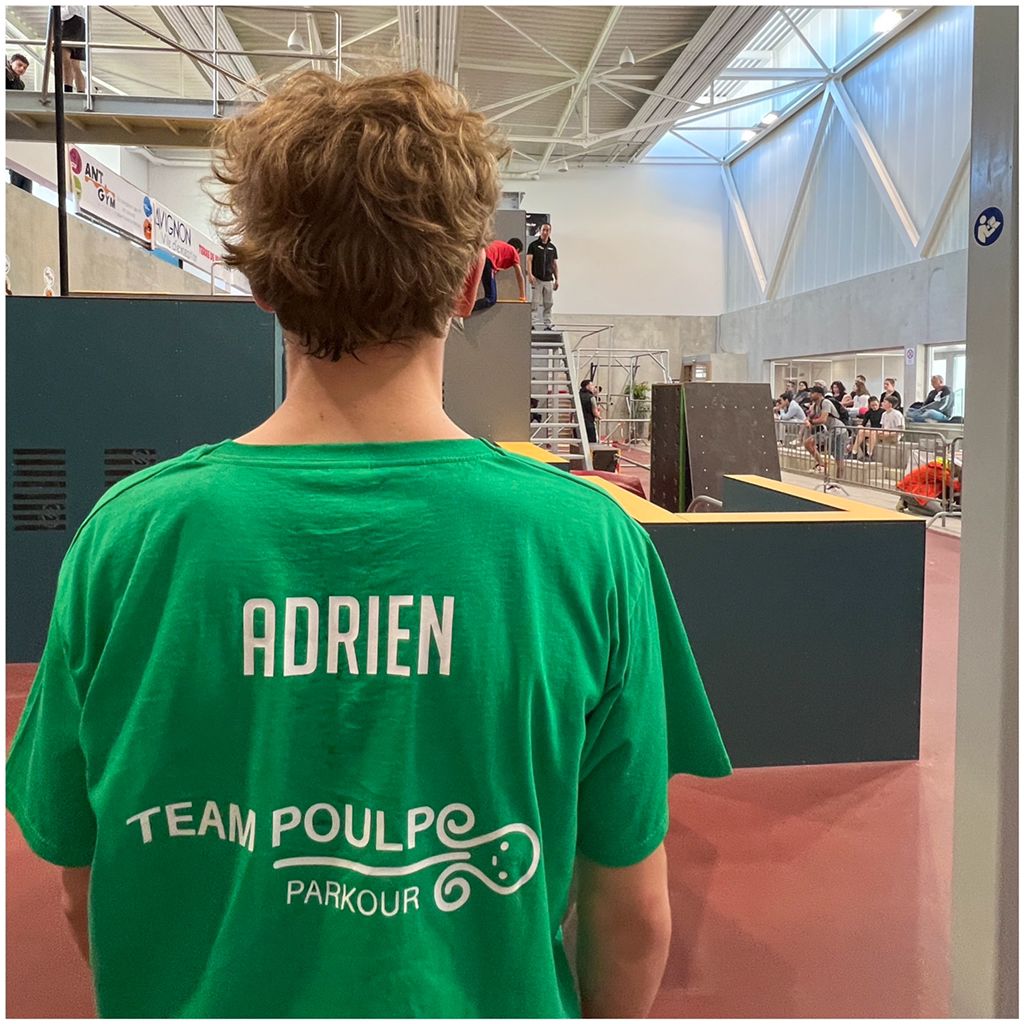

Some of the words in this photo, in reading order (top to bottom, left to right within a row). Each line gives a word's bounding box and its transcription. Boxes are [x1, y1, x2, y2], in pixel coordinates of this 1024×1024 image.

[85, 162, 103, 184] ANT
[97, 188, 116, 209] GYM
[154, 207, 192, 247] AVIGNON
[242, 594, 455, 677] ADRIEN
[126, 800, 257, 852] TEAM
[286, 879, 420, 917] PARKOUR
